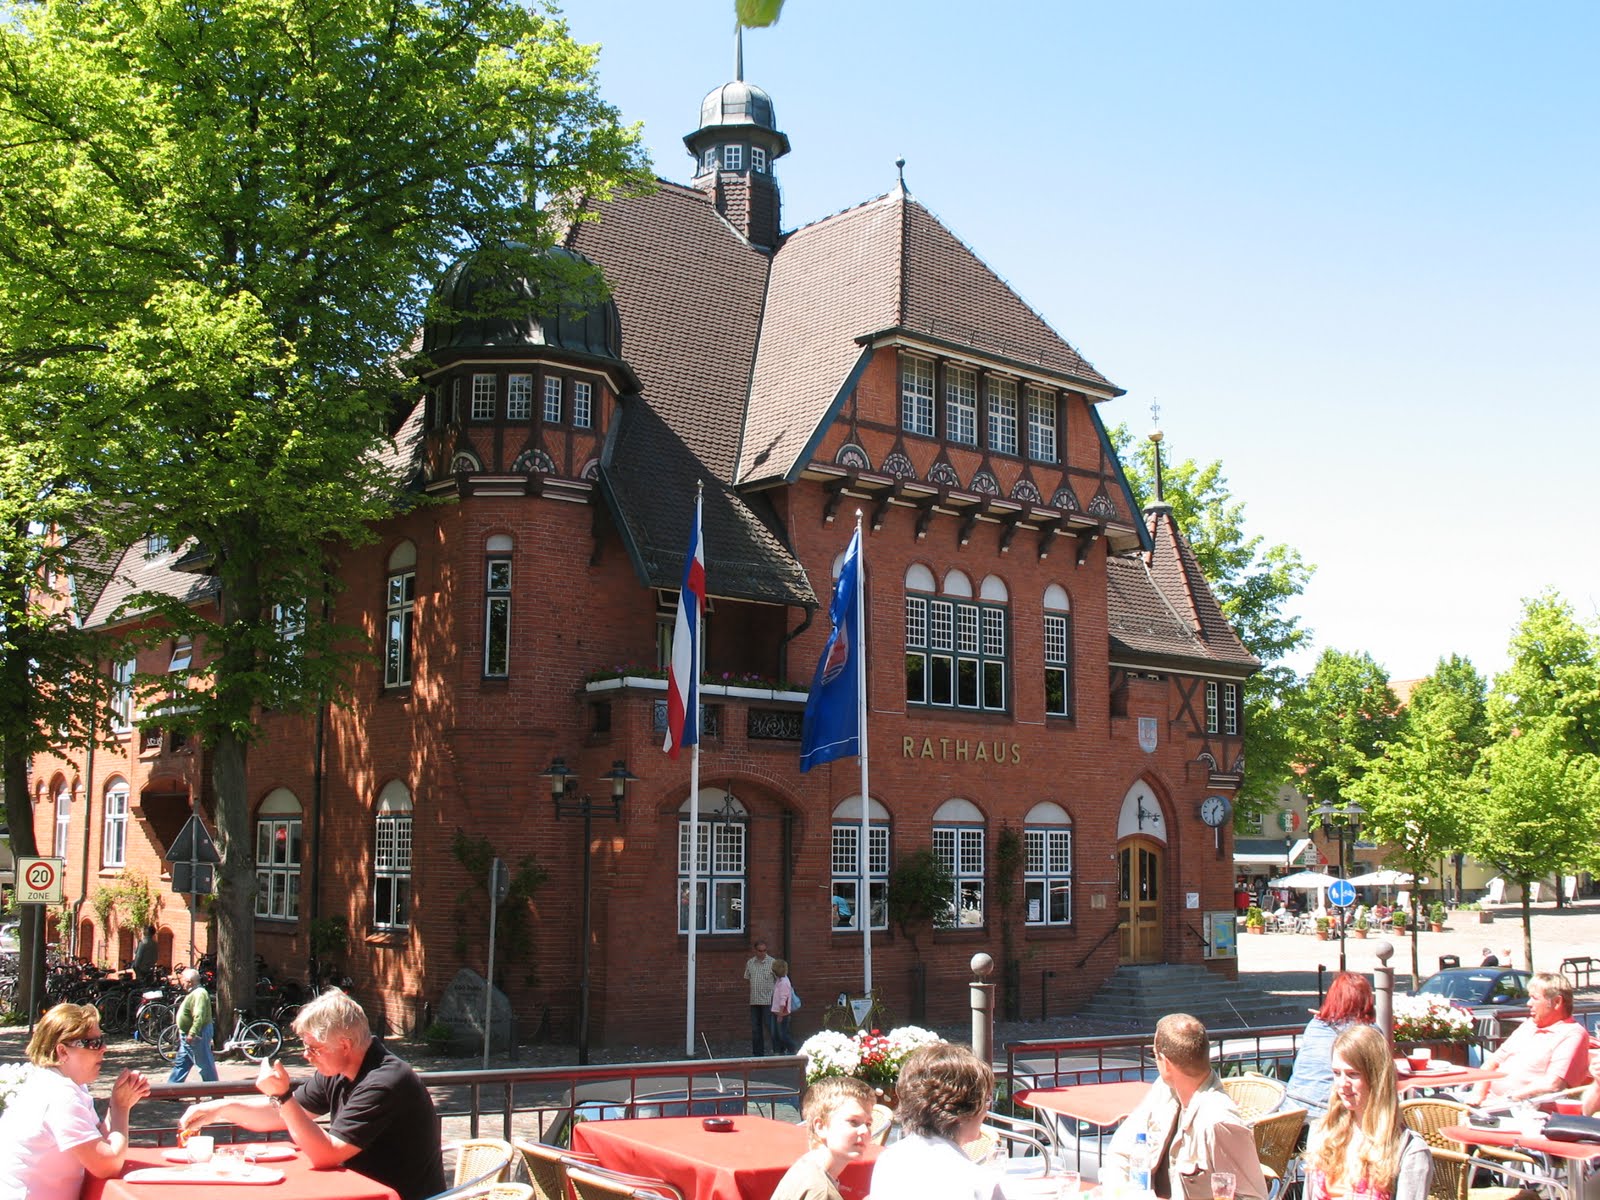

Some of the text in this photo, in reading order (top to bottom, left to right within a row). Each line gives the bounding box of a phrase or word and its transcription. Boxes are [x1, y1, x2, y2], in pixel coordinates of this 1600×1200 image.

[903, 736, 1021, 764] RATHAUS
[32, 869, 49, 883] 20
[27, 892, 50, 900] ZONE
